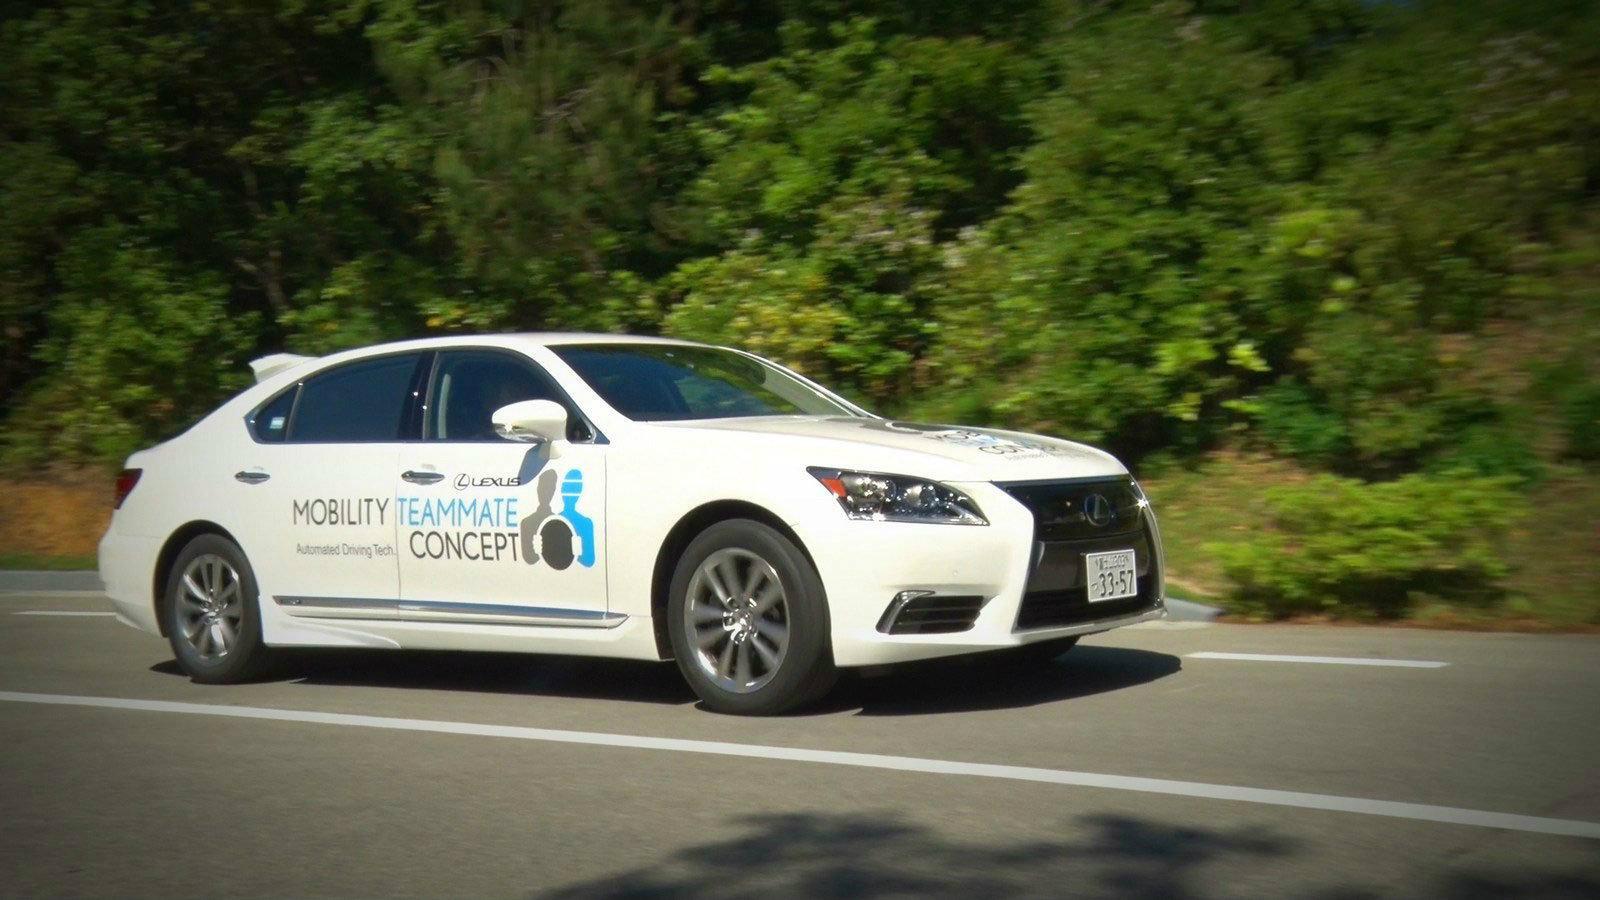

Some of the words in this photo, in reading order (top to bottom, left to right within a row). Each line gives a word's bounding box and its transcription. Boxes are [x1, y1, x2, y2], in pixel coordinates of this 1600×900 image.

[472, 477, 521, 487] LEXUS
[293, 498, 389, 525] MOBILITY
[398, 498, 518, 527] TEAMMATE
[296, 543, 340, 555] Automated
[342, 543, 371, 559] Driving
[410, 530, 519, 561] CONCEPT
